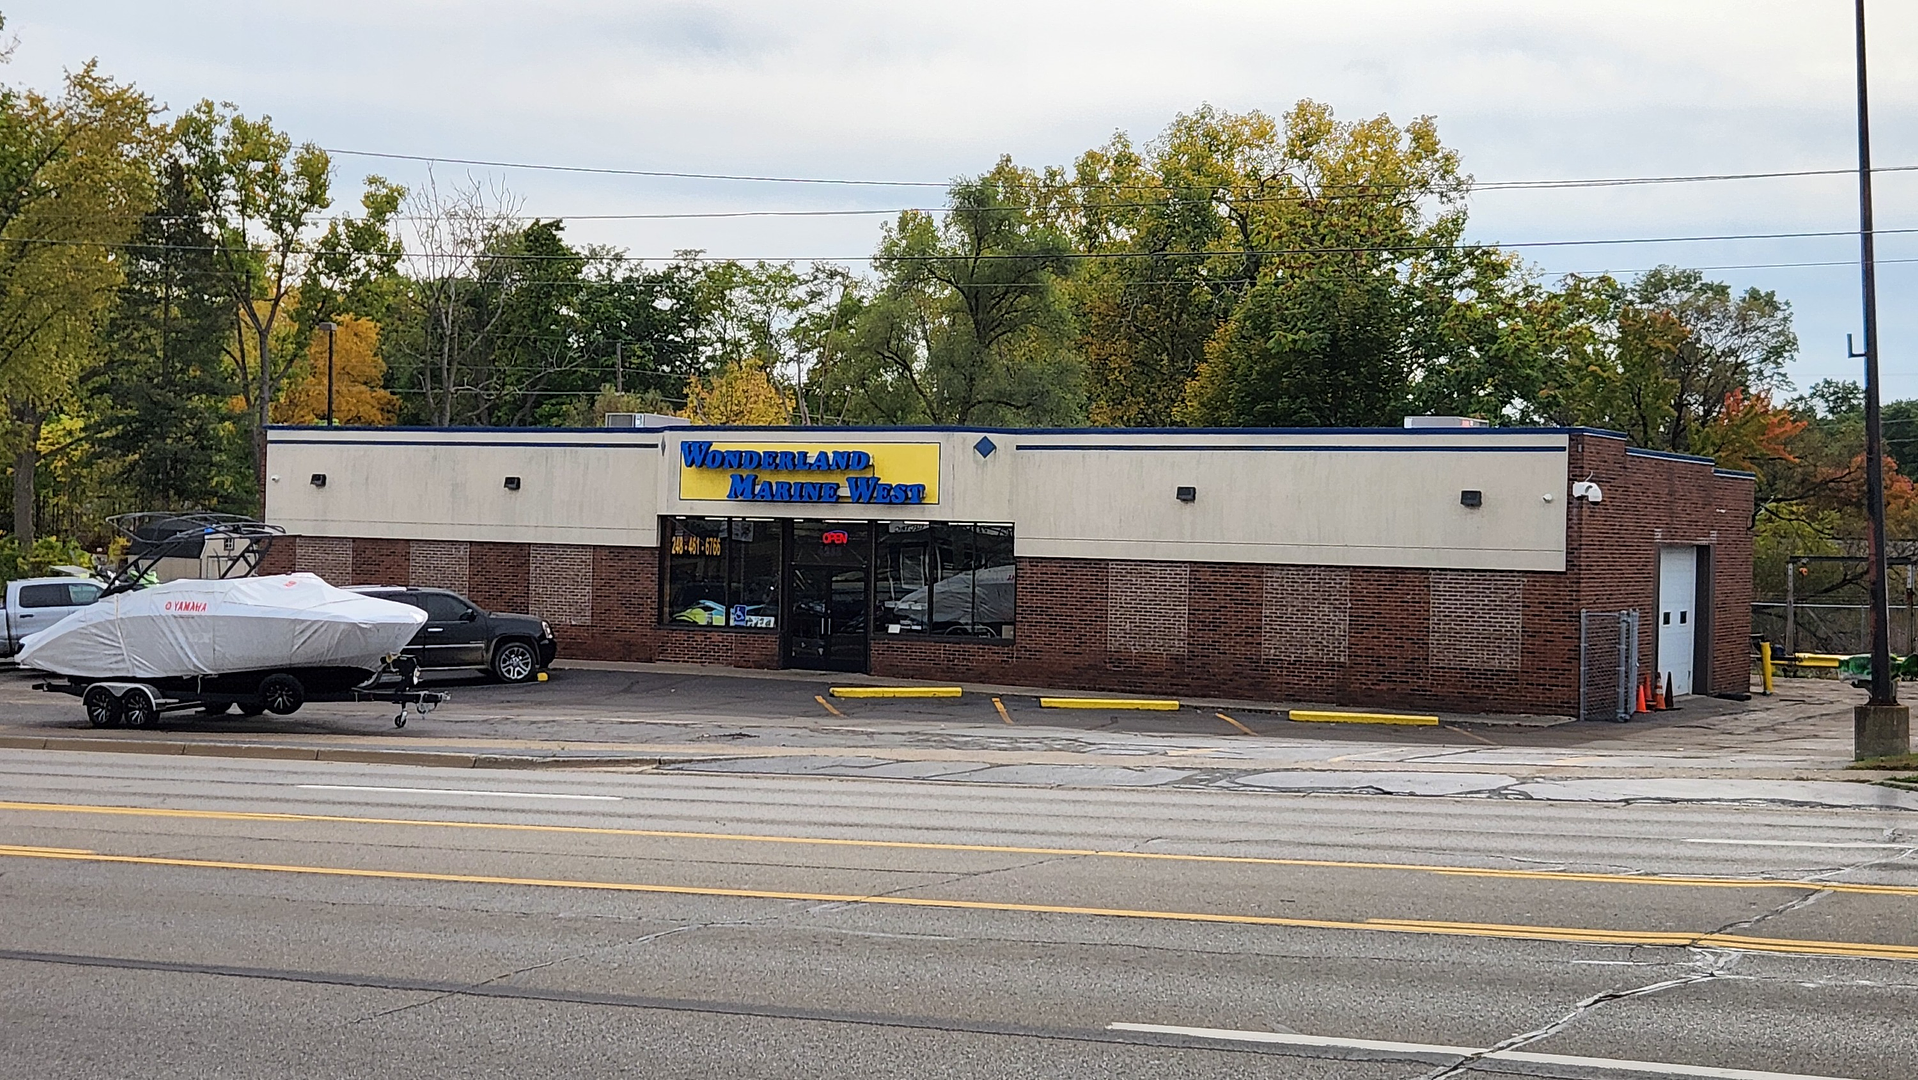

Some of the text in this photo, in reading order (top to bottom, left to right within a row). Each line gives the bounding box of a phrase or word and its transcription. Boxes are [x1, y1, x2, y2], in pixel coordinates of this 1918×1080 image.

[681, 441, 871, 471] WONDERLAND
[726, 473, 926, 504] MARINE WEST
[822, 532, 848, 544] OPEN
[174, 601, 207, 612] YAMAHA
